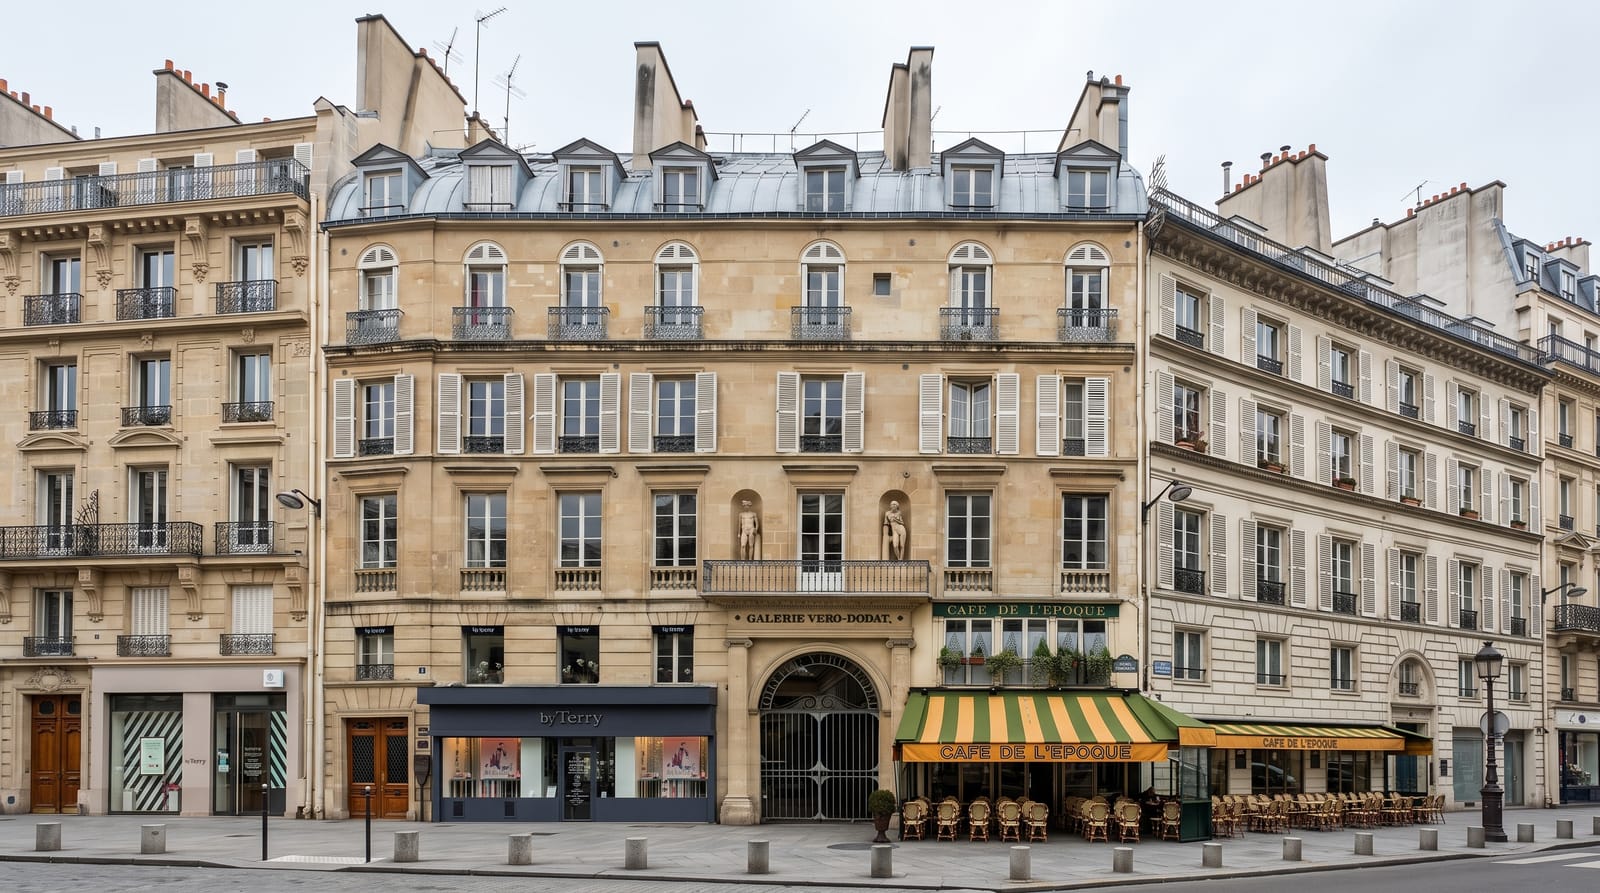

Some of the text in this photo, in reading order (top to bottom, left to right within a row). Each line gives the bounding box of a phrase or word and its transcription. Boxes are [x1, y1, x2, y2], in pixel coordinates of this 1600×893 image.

[947, 605, 1106, 617] CAFE DE L'EPOQUE
[747, 614, 805, 624] GALERIE
[540, 710, 602, 727] by Terry
[1263, 738, 1338, 749] CAFE DE L'EPOQUE
[940, 745, 1132, 760] CAFE DE L'EPOQUE
[190, 758, 207, 766] Terry
